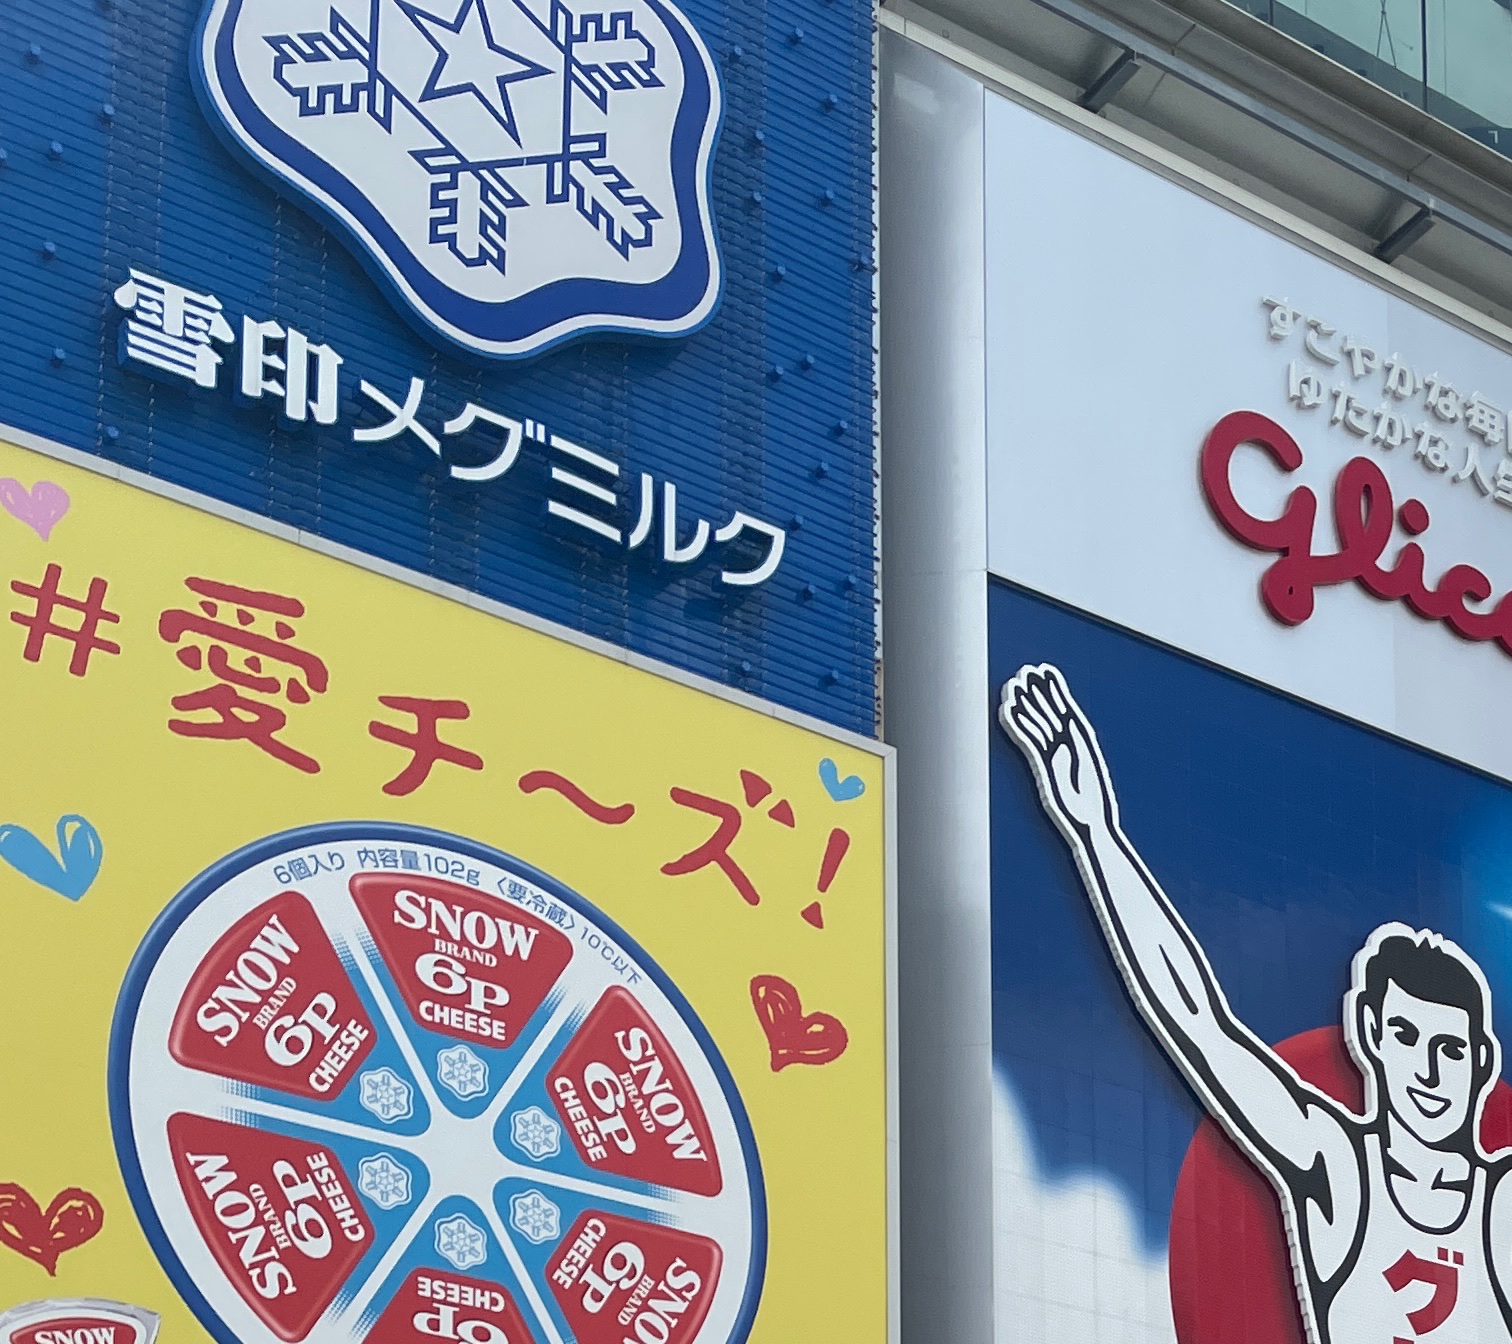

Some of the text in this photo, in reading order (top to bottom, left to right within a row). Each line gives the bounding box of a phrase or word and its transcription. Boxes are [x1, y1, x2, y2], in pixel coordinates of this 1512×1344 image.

[113, 267, 786, 586] 雪印メグミルク
[393, 889, 539, 961] SNOW
[434, 937, 498, 968] BRAND
[197, 915, 300, 1047] SNOW
[253, 976, 297, 1031] BRAND
[414, 952, 510, 1015] 6P
[265, 992, 340, 1067] 6P
[308, 1019, 369, 1093] CHEESE
[418, 1000, 506, 1041] CHEESE
[554, 1076, 608, 1162] CHEESE
[584, 1062, 636, 1154] 6P
[614, 1027, 708, 1163] SNOW
[620, 1072, 656, 1133] BRAND
[186, 1152, 297, 1299] SNOW
[250, 1183, 292, 1250] BRAND
[272, 1160, 333, 1259] 6P
[306, 1152, 366, 1242] CHEESE
[552, 1218, 607, 1289] CHEESE
[580, 1241, 646, 1313] 6P
[416, 1276, 505, 1313] CHEESE
[617, 1277, 656, 1326] BRAND
